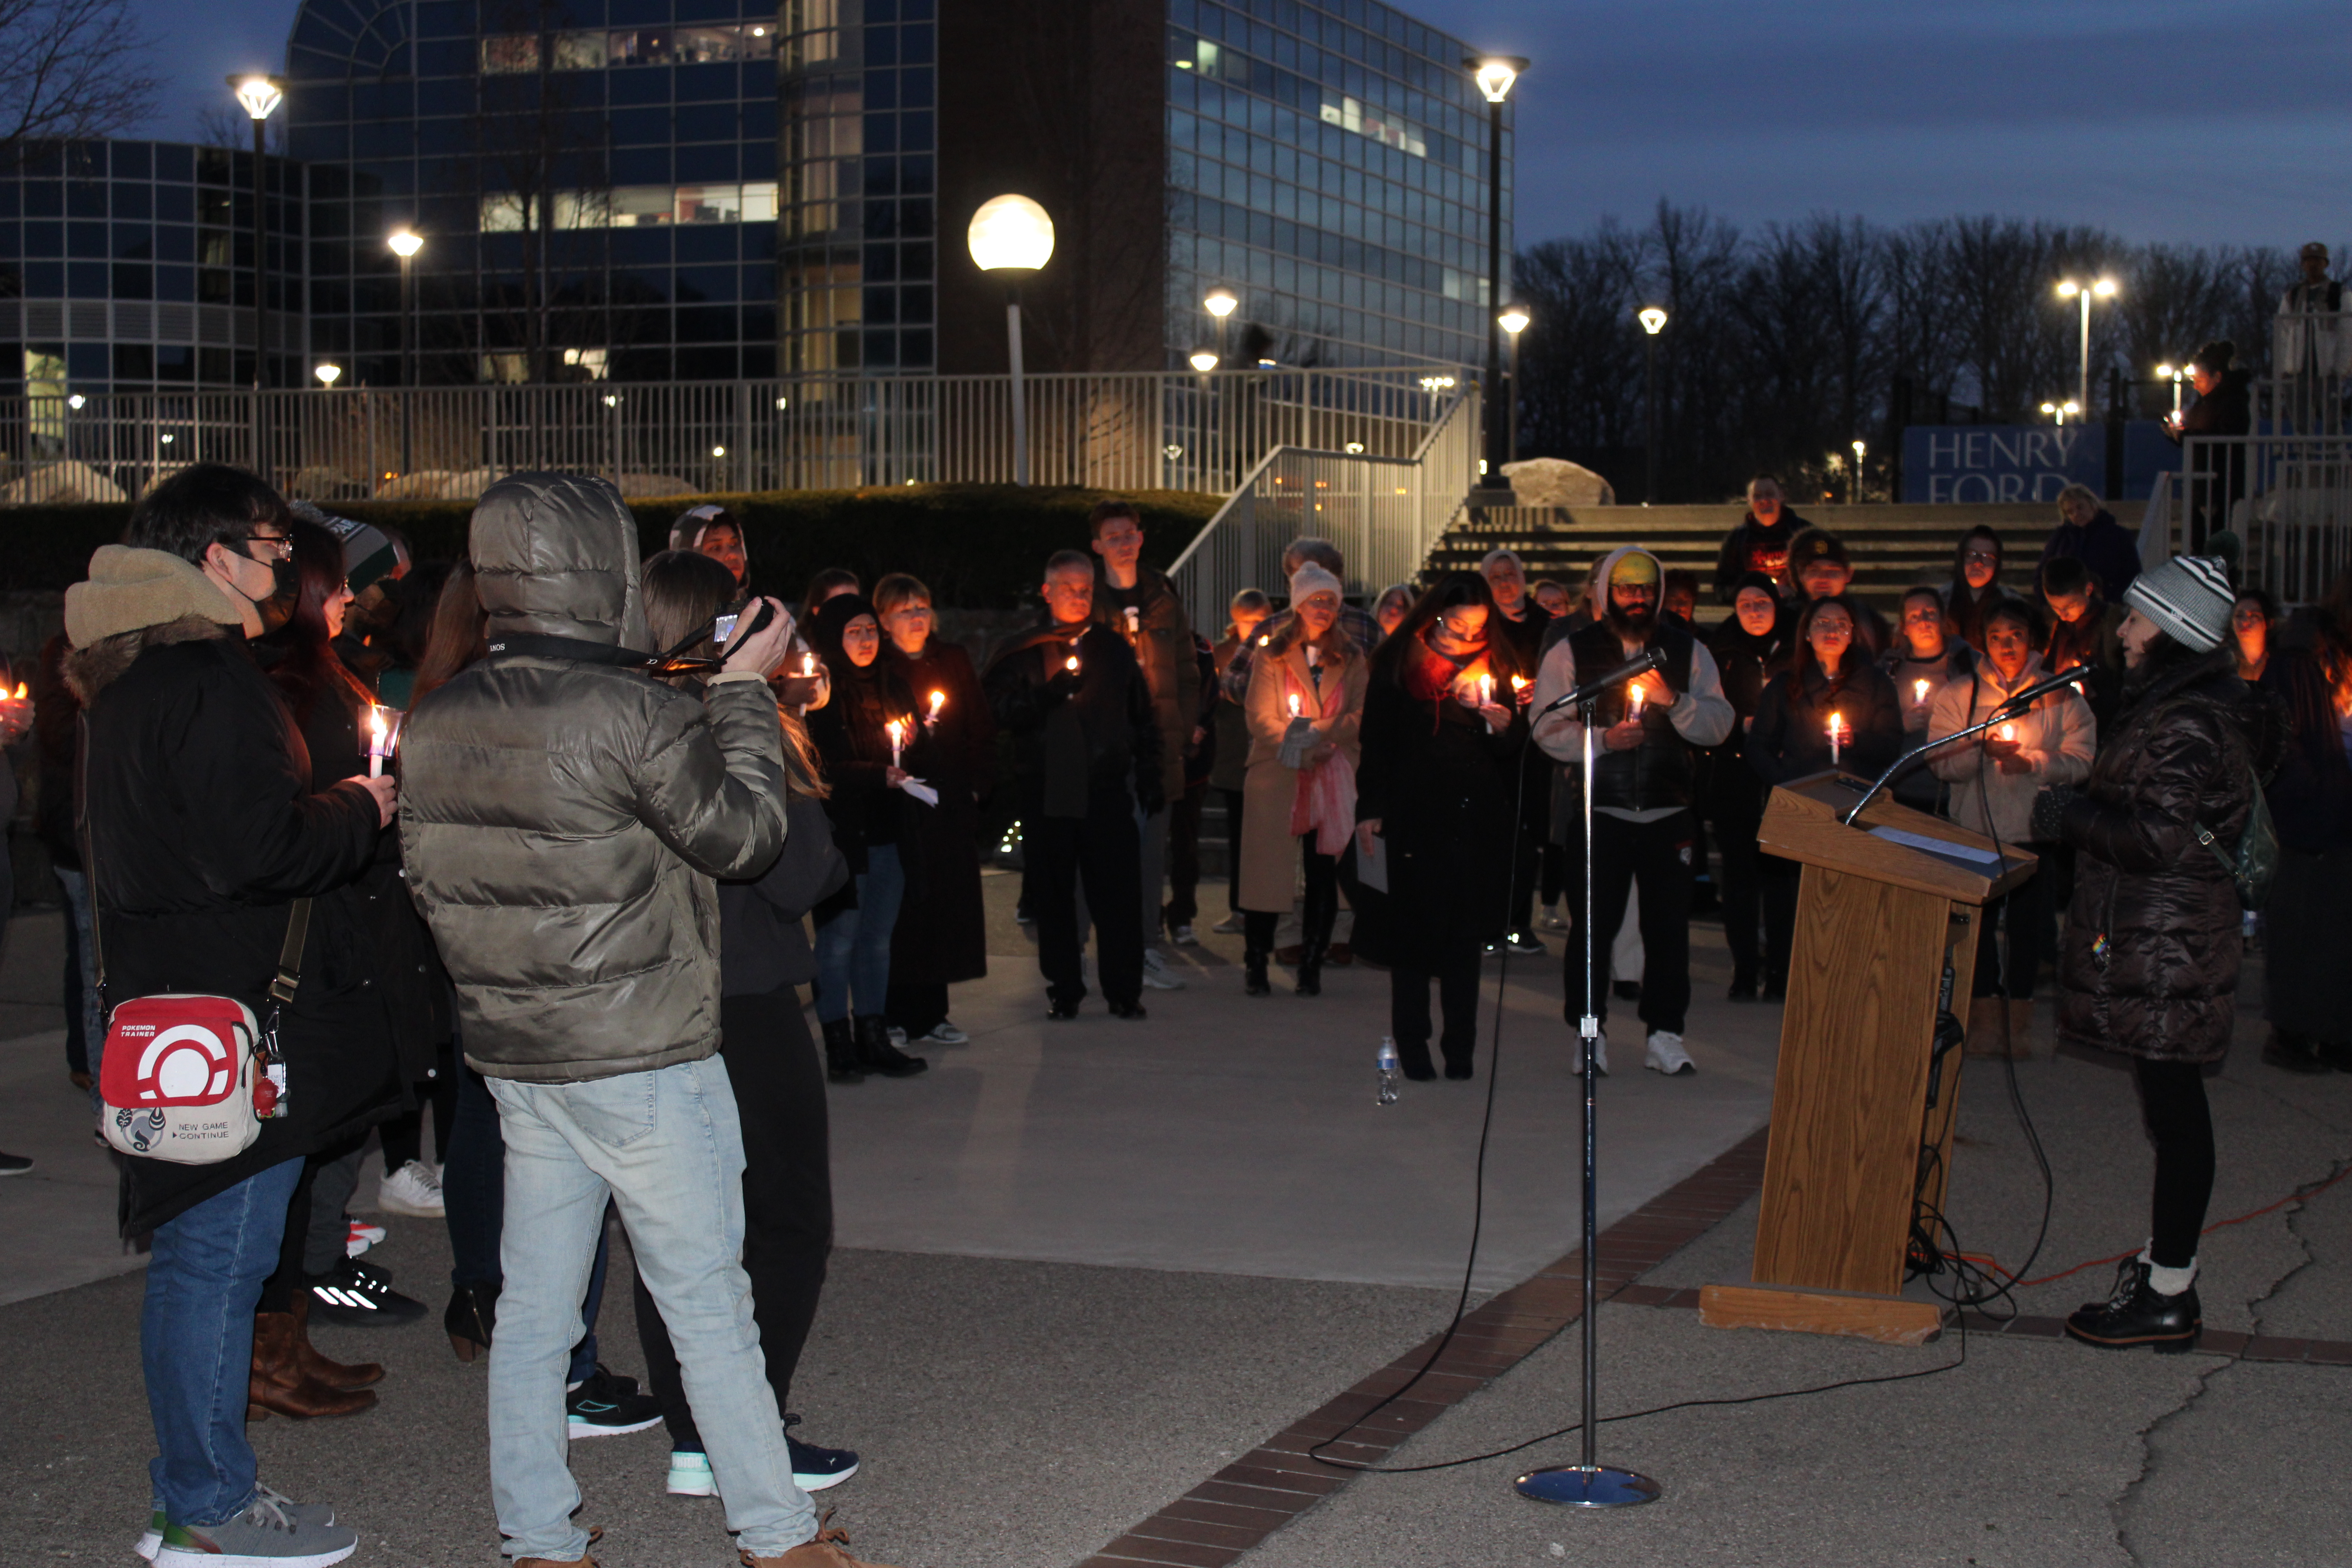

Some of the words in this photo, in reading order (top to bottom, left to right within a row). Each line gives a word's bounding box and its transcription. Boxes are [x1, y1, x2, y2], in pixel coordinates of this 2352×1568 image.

[1929, 428, 2077, 468] HENRY
[1929, 473, 2071, 503] FORD
[490, 643, 505, 652] SONY
[202, 1122, 228, 1130] GAME
